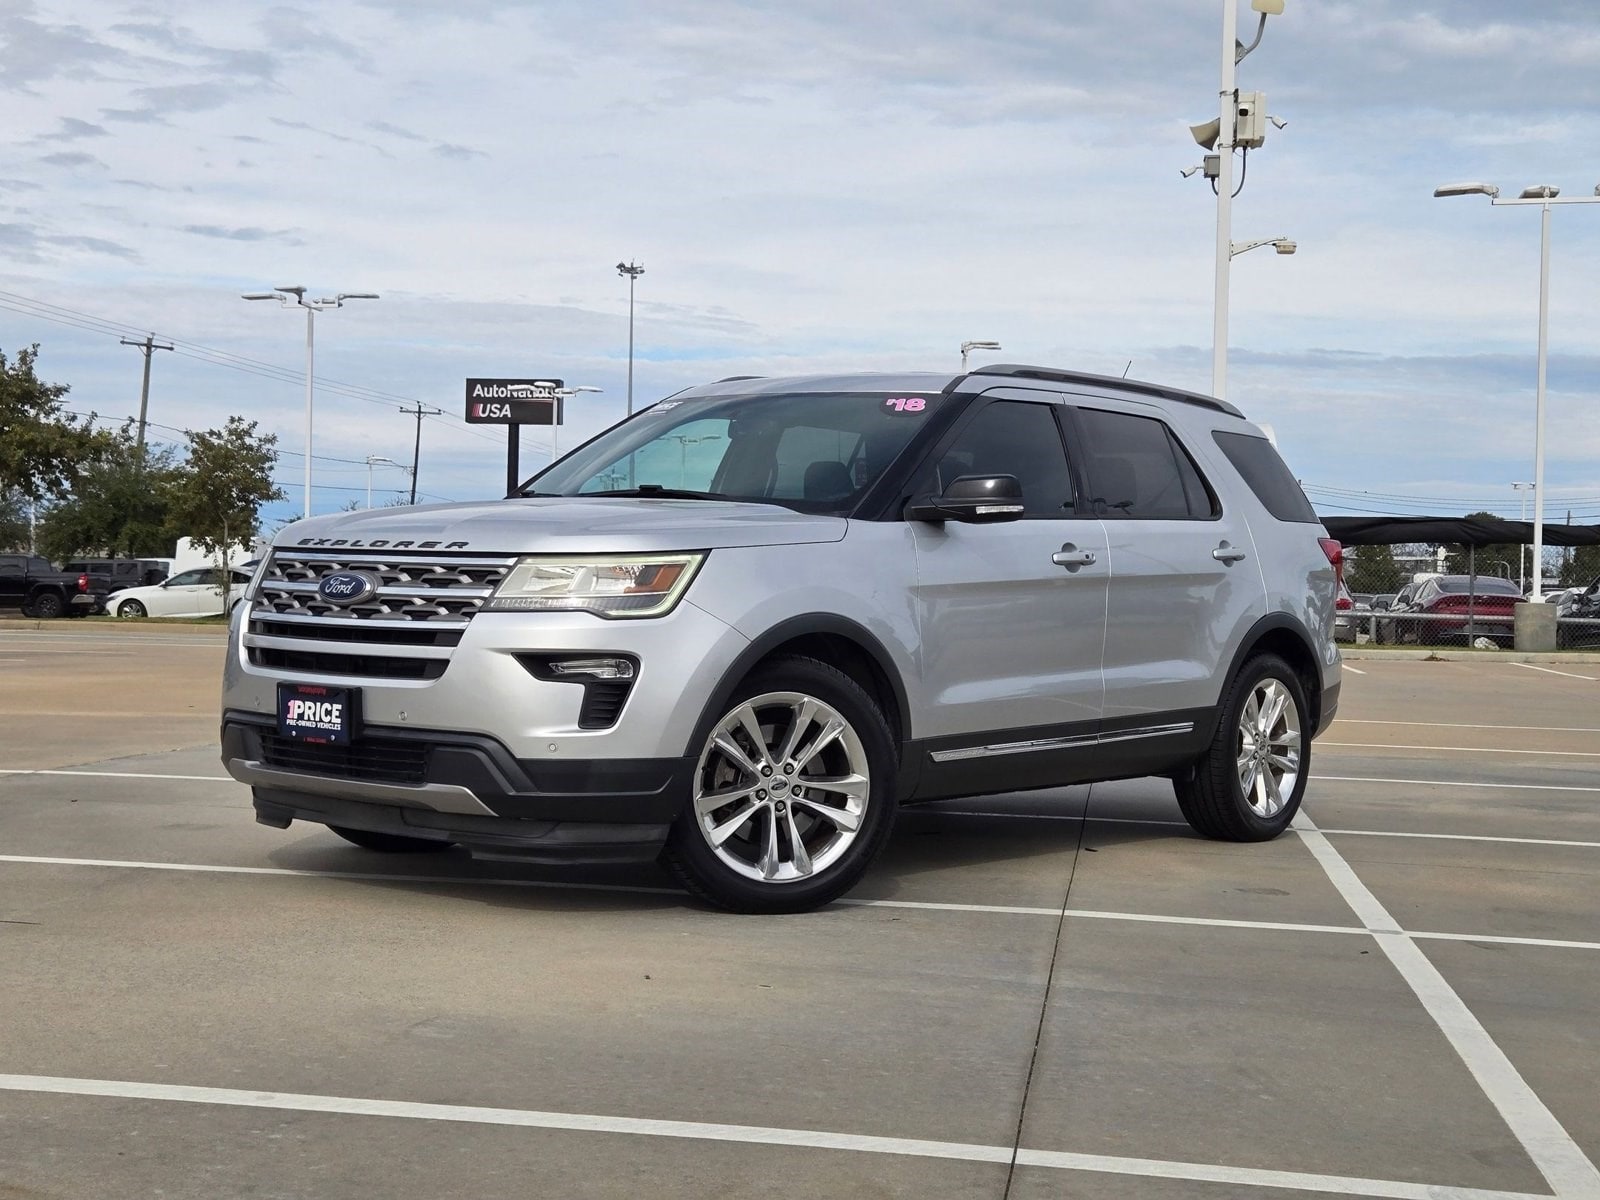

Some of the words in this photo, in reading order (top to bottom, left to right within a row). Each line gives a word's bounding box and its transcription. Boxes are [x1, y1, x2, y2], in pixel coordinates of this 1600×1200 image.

[478, 403, 512, 418] USA
[886, 397, 926, 411] '18
[297, 538, 470, 549] EXPLORER
[325, 576, 354, 593] Ford
[317, 722, 341, 731] VEHICLES
